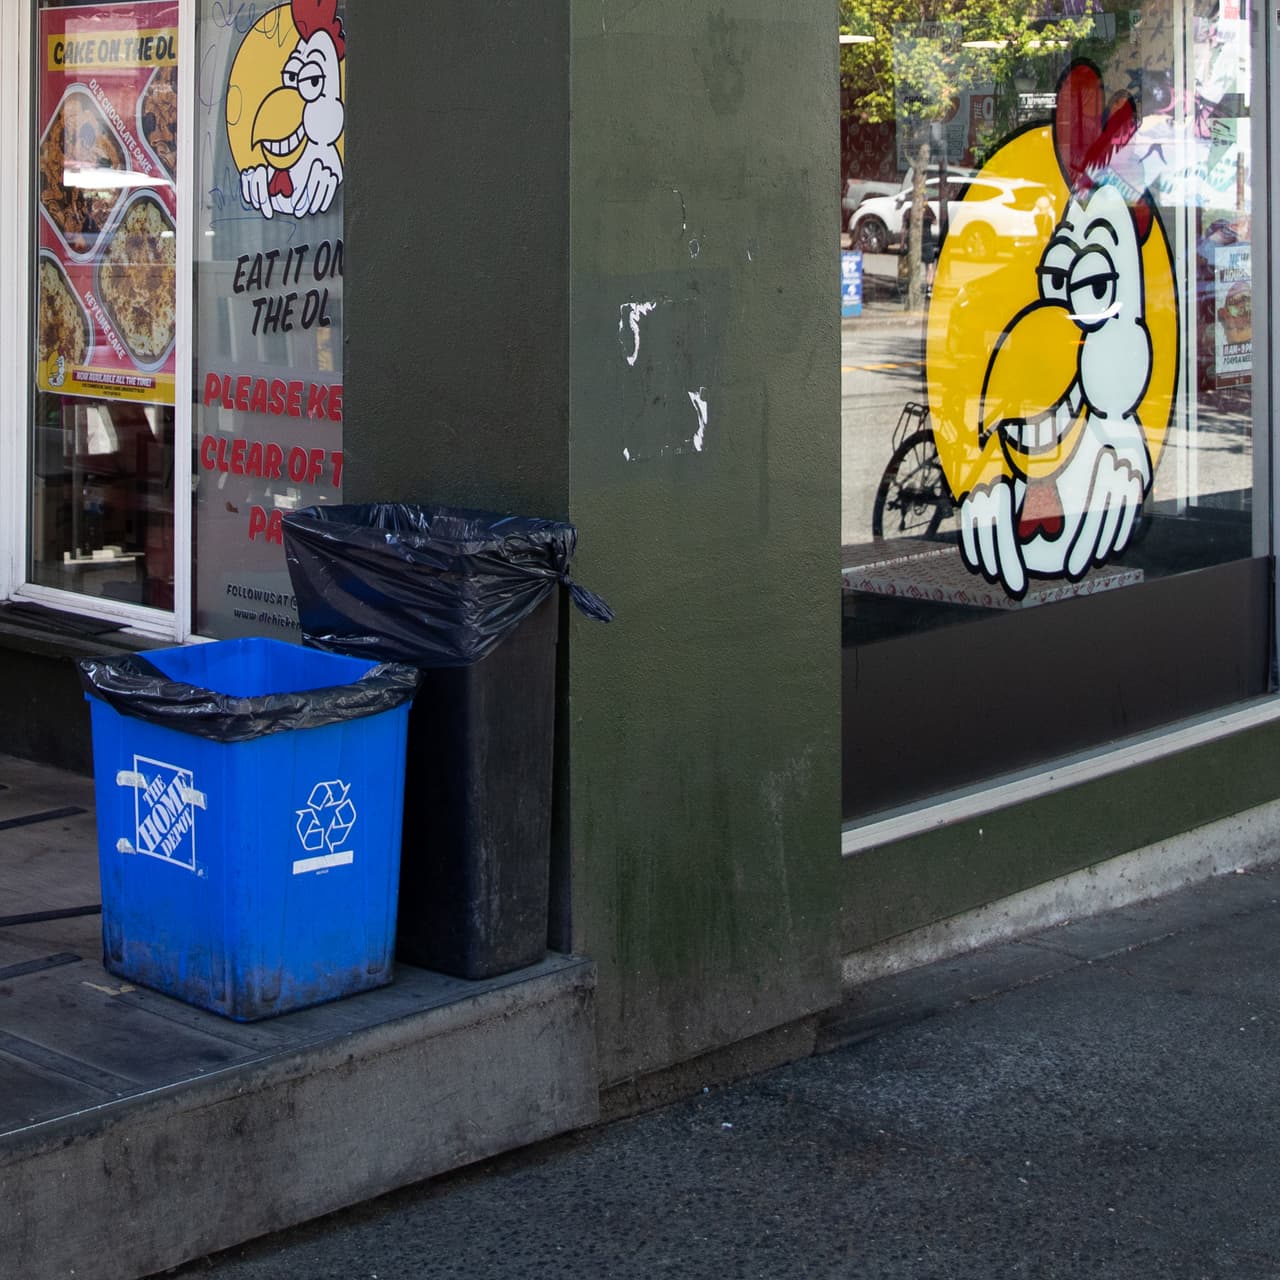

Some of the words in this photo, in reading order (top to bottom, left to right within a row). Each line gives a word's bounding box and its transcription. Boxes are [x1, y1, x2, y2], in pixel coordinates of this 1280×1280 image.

[53, 39, 96, 65] CAKE
[98, 38, 120, 63] ON
[124, 36, 152, 61] THE
[155, 35, 176, 61] DL
[101, 97, 136, 153] CHOCOLATE
[133, 148, 153, 175] CAKE
[233, 249, 280, 294] EAT
[282, 244, 309, 286] IT
[84, 291, 99, 311] KEY
[95, 309, 111, 334] LIME
[108, 331, 126, 360] CAKE
[252, 292, 297, 336] THE
[301, 287, 331, 330] DL
[116, 375, 125, 384] ALL
[126, 376, 136, 386] THE
[203, 372, 304, 418] PLEASE
[200, 434, 285, 480] CLEAR
[288, 446, 325, 485] OF
[226, 584, 263, 601] FOLLOW
[263, 591, 276, 604] US
[276, 595, 289, 607] AT
[142, 774, 166, 808] THE
[161, 807, 193, 858] DEPOT
